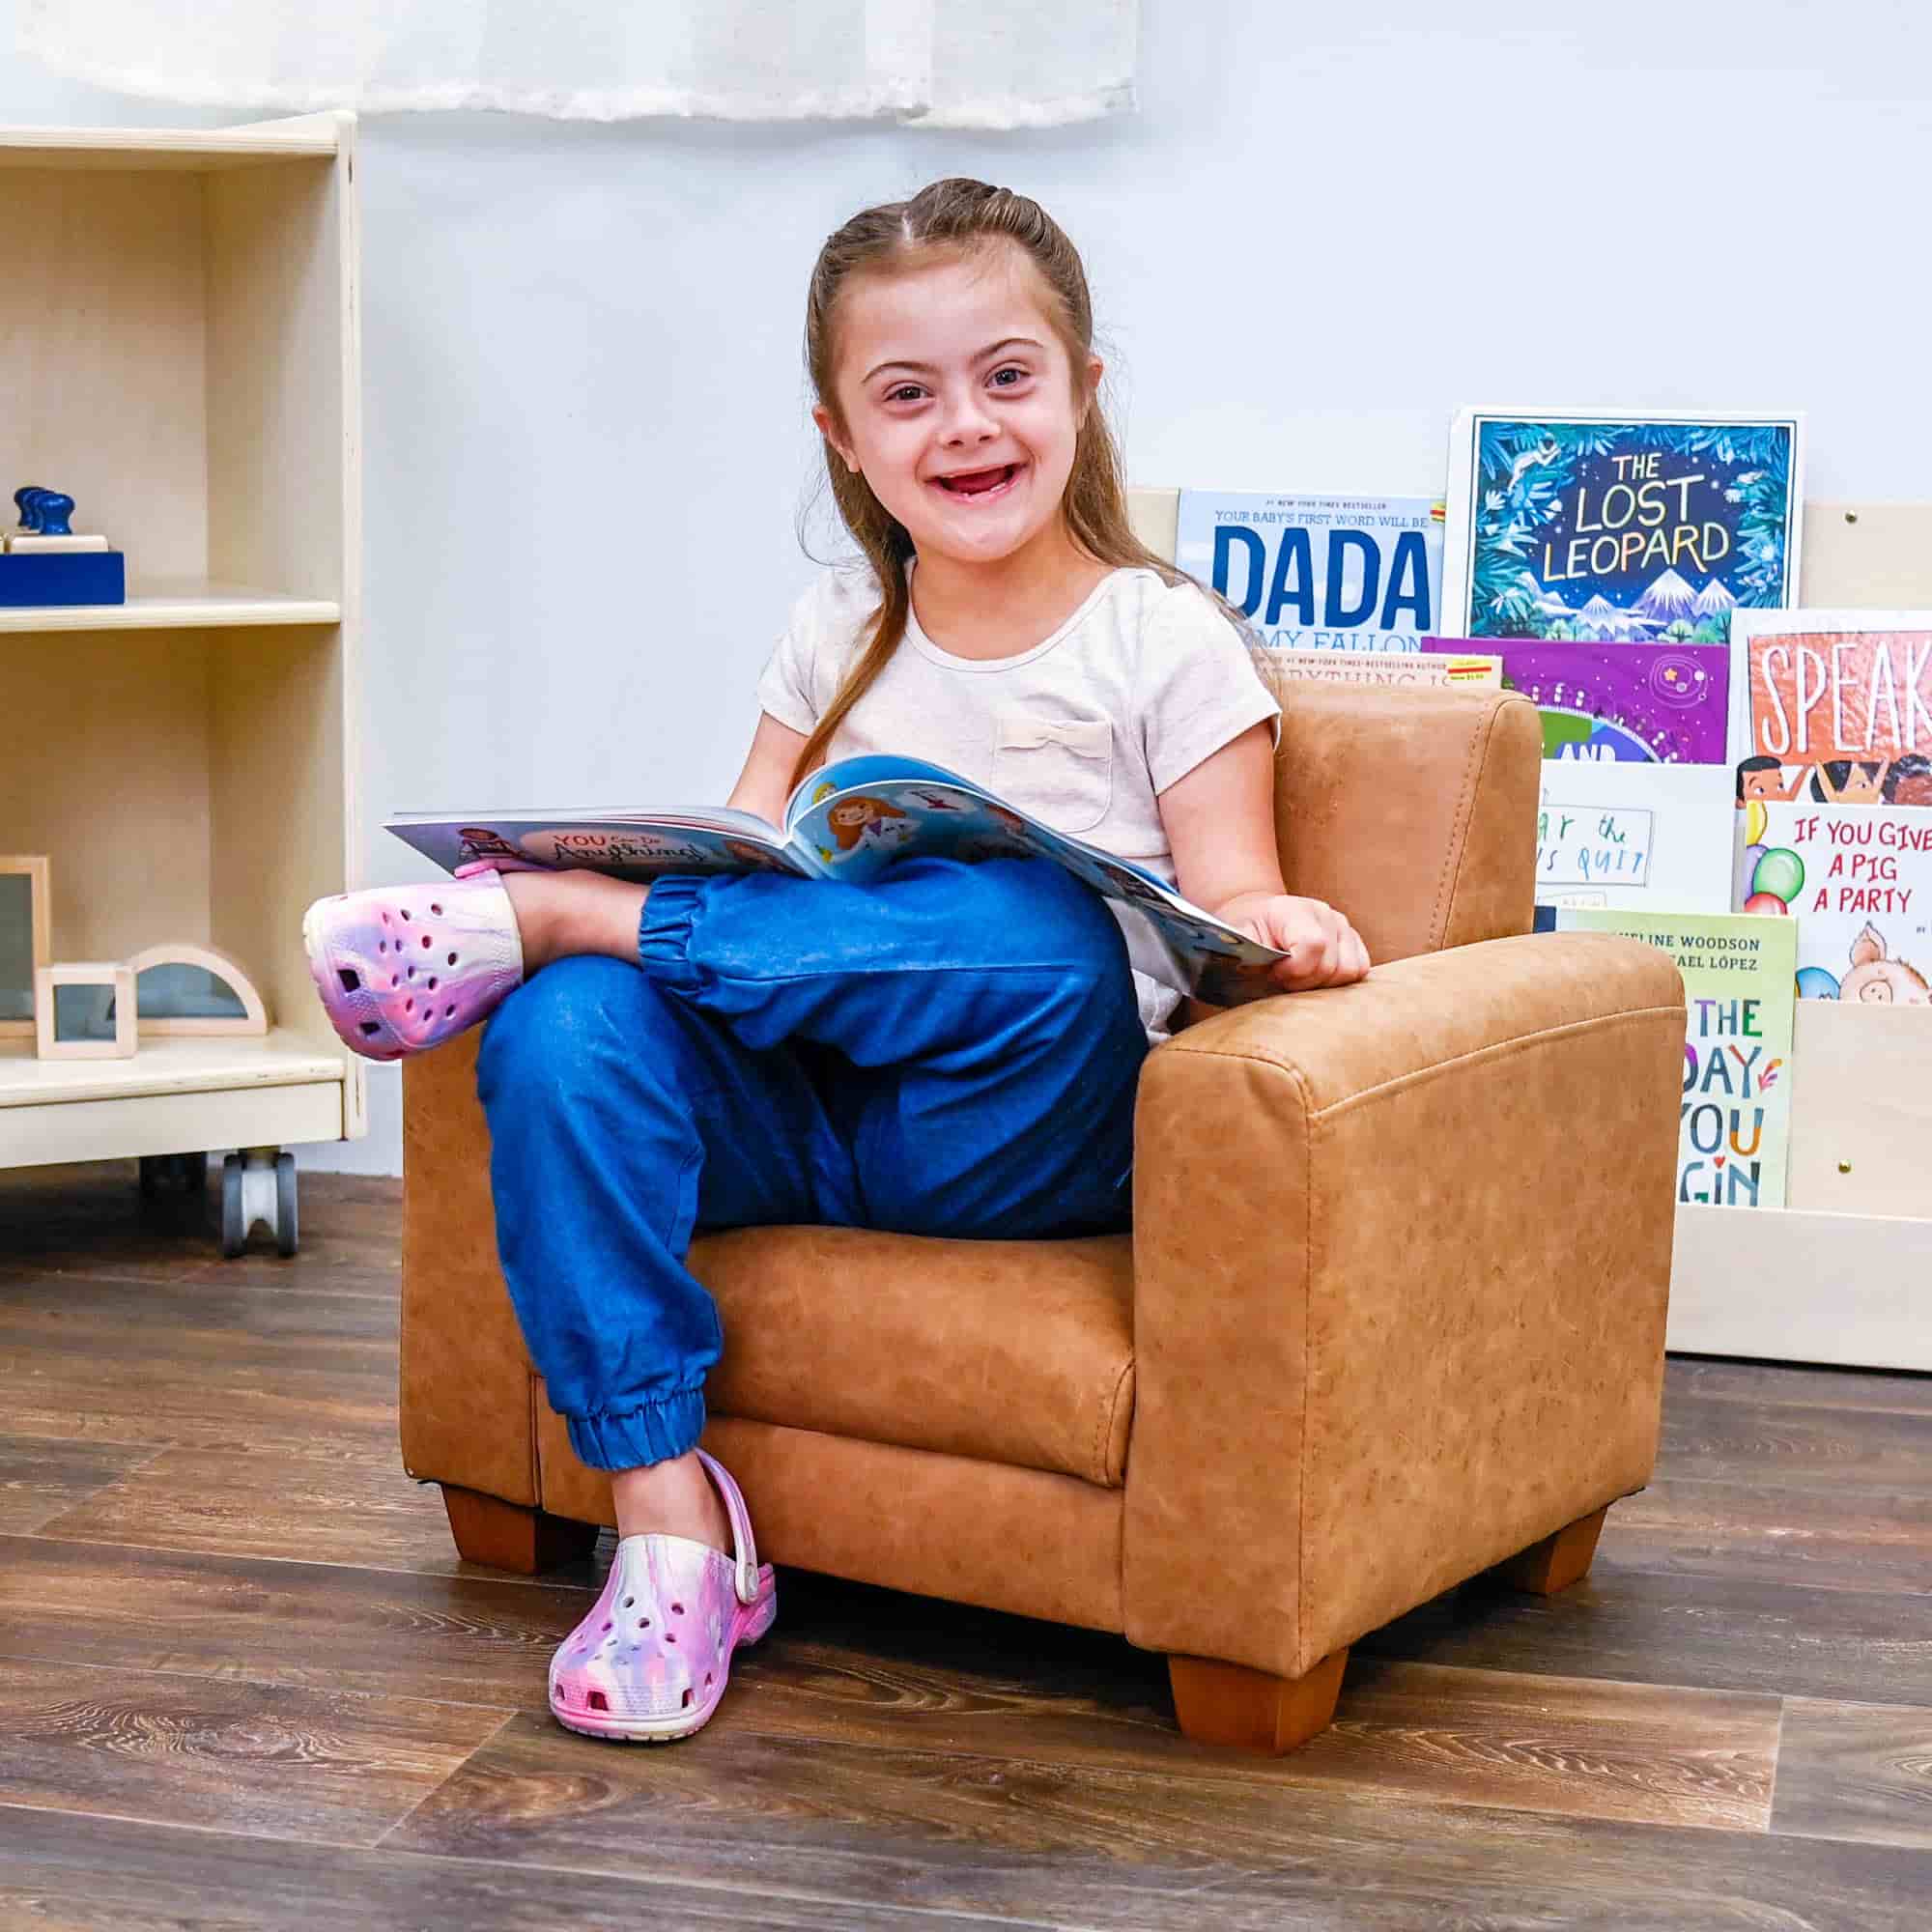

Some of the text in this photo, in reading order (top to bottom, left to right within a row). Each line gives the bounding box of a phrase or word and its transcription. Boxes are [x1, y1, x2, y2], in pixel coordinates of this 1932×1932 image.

[1612, 453, 1662, 481] THE
[1577, 474, 1705, 533] LOST
[1215, 510, 1429, 528] YOUR BABY'S FIRST WORD WILL BE
[1544, 523, 1729, 582] LEOPARD
[1212, 526, 1431, 631] DADA
[1762, 640, 1932, 755] SPEAK
[1561, 743, 1616, 762] AND
[554, 836, 606, 846] YOU
[1795, 815, 1932, 851] IF YOU GIVE
[1828, 853, 1897, 883] A PIG
[1813, 887, 1912, 914] A PARTY
[1681, 936, 1761, 952] WOODSON
[1669, 953, 1757, 972] AEL LÓPEZ
[1693, 999, 1763, 1037] THE
